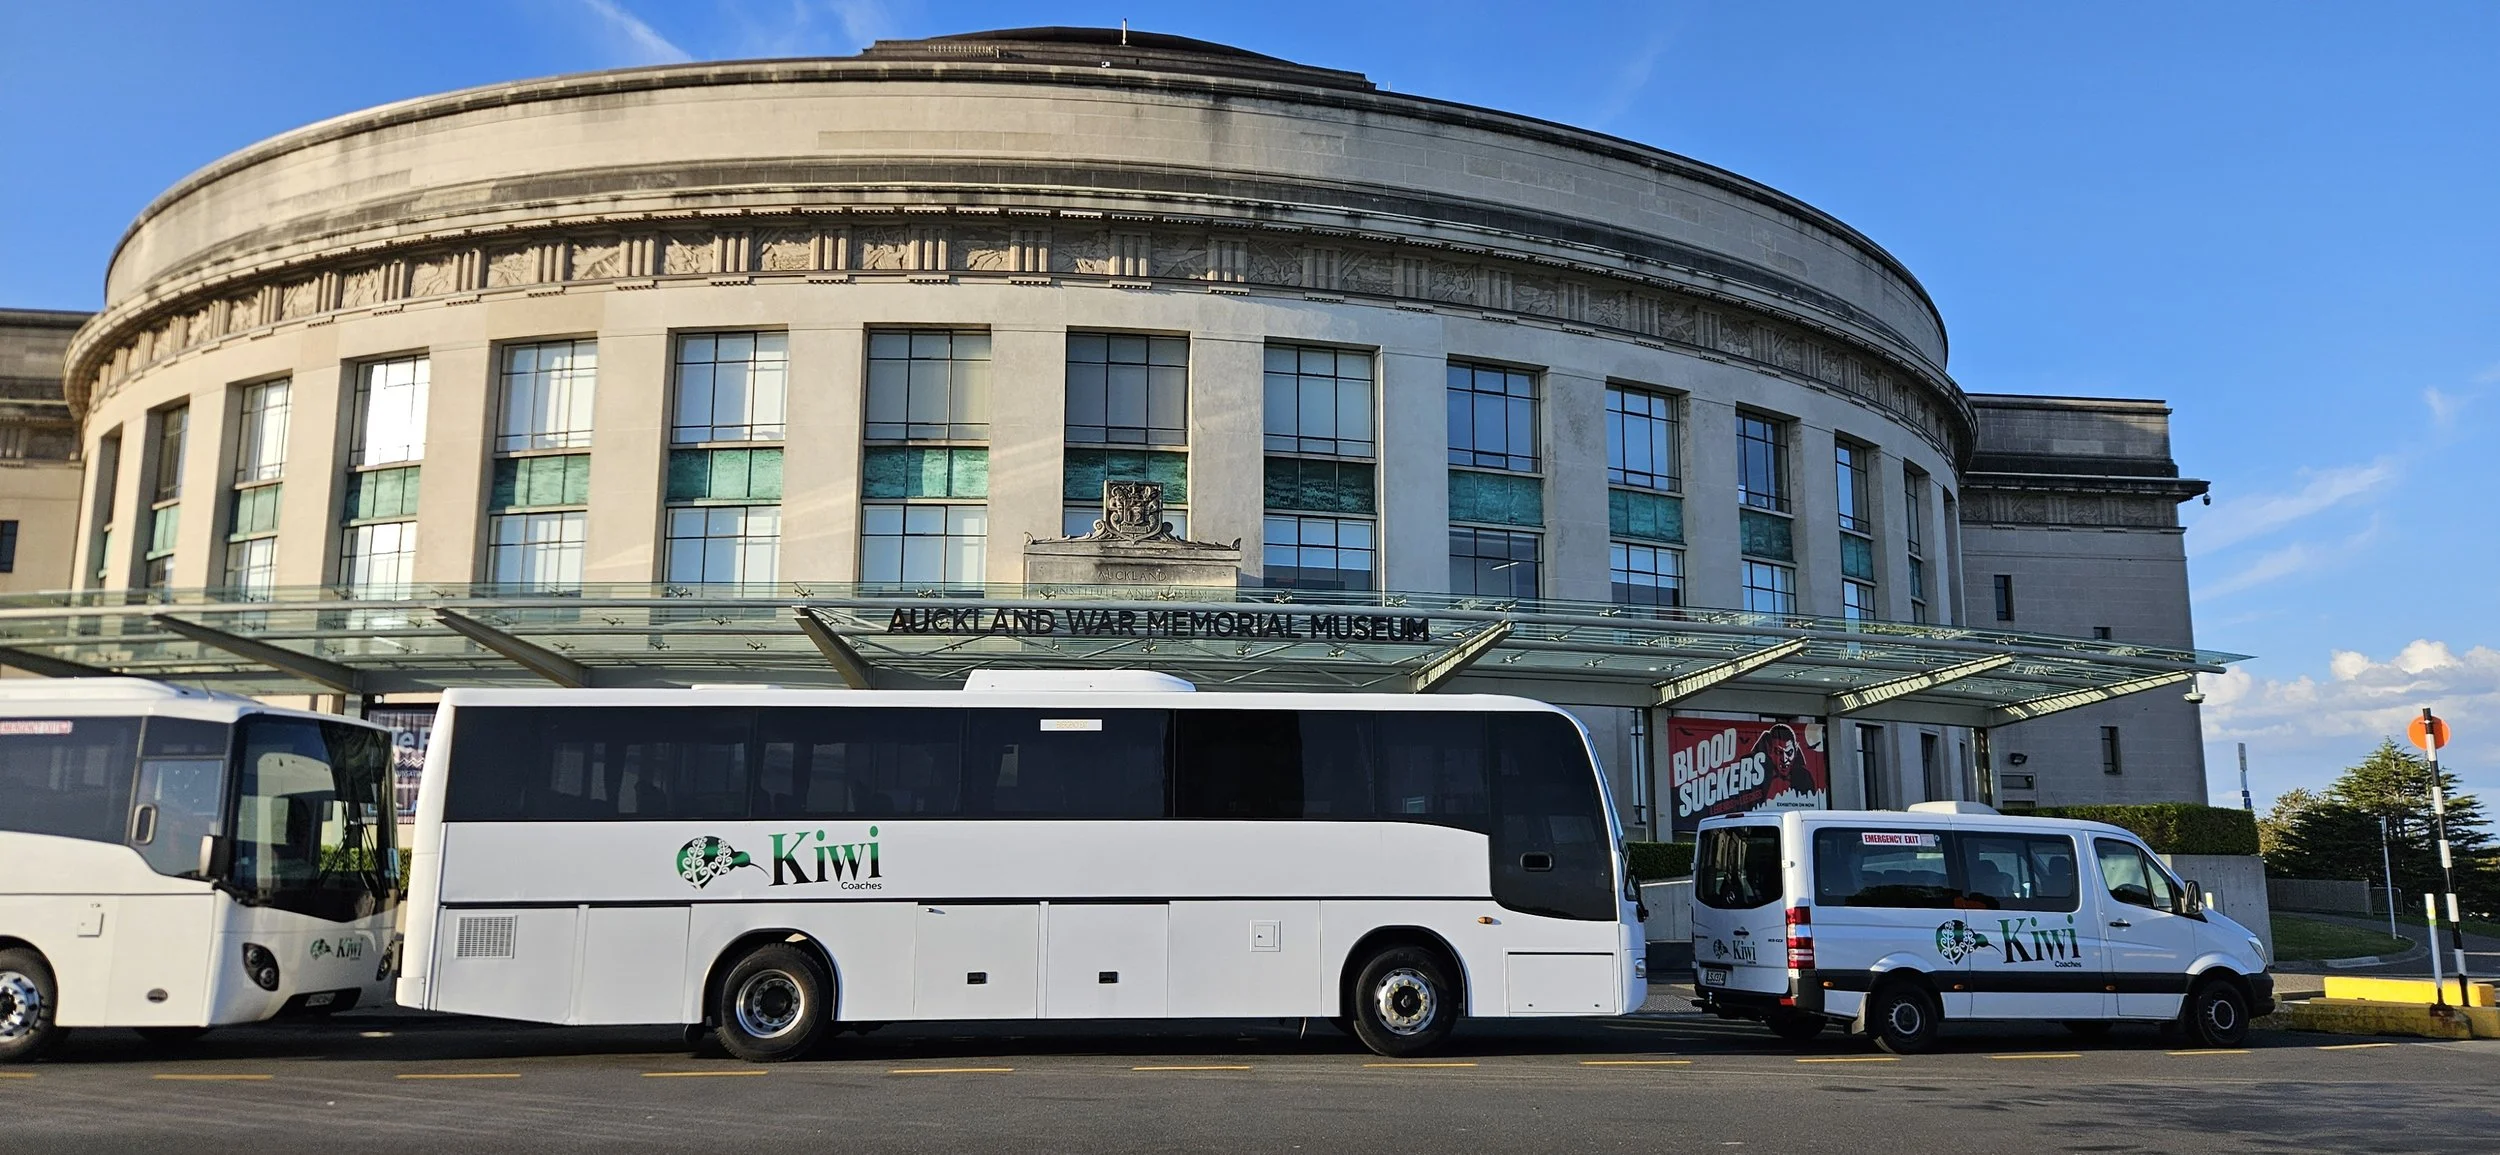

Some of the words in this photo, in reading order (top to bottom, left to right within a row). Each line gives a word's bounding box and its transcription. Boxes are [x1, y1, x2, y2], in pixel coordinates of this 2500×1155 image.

[1098, 569, 1168, 582] AUCKLAND
[1127, 587, 1155, 599] AND
[887, 607, 1056, 635] AUCKLAND
[1065, 608, 1137, 636] WAR
[1147, 610, 1302, 639] MEMORIAL
[1310, 614, 1430, 643] MUSEUM
[1673, 728, 1737, 787] BLOOD
[1679, 752, 1766, 818] SUCKERS
[1864, 834, 1902, 844] EMERGENCY
[1904, 835, 1919, 844] EXIT
[768, 825, 883, 887] Kiwi
[841, 881, 882, 890] Coaches
[336, 937, 364, 958] Kiwi
[1997, 914, 2082, 964] Kiwi
[1732, 940, 1757, 960] Kiwi
[2055, 960, 2082, 968] Coaches
